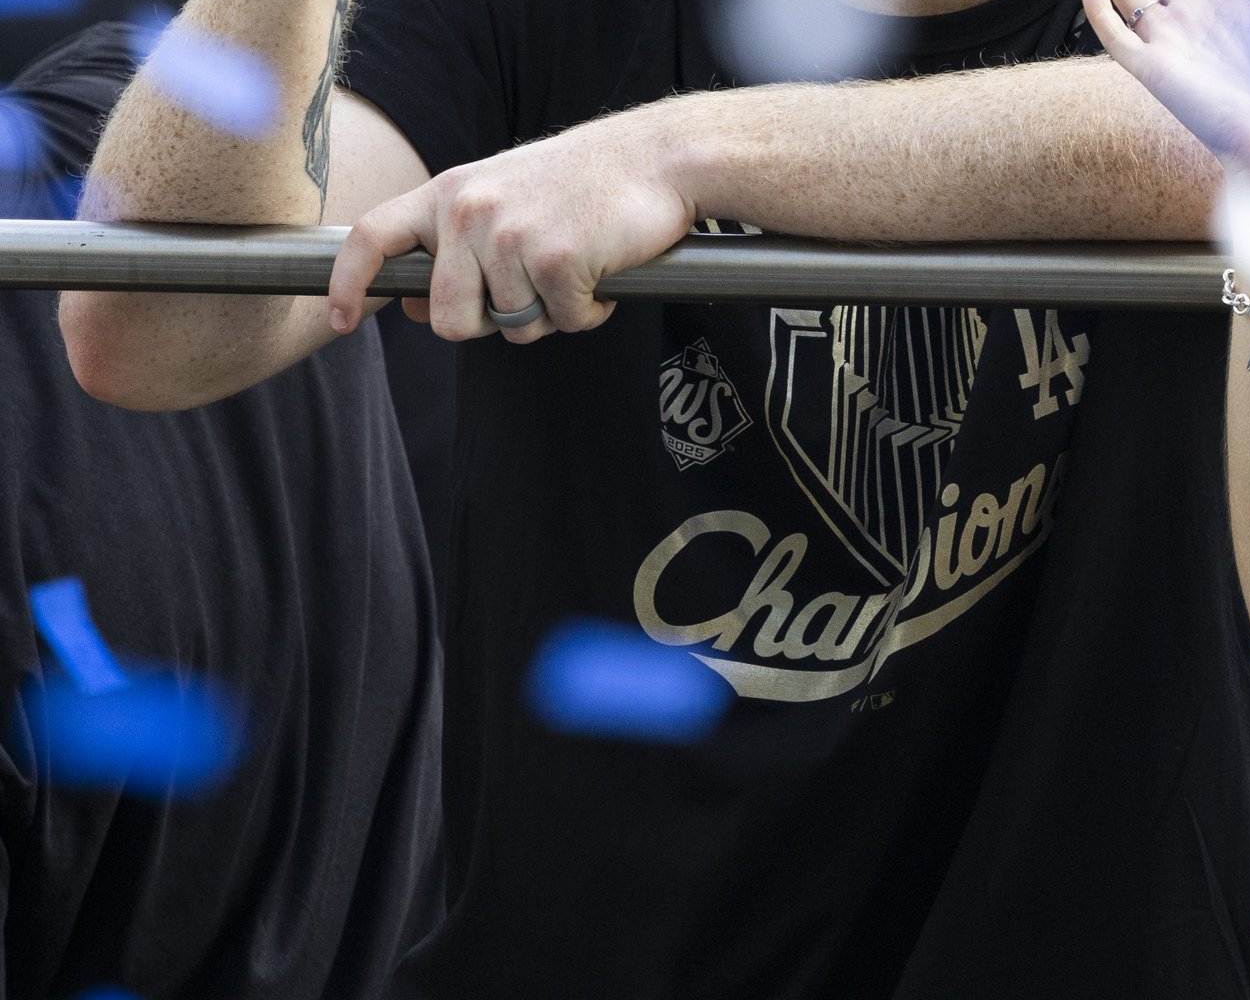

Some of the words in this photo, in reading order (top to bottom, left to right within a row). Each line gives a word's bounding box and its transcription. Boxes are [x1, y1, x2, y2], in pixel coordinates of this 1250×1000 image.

[659, 368, 733, 445] WS
[1013, 308, 1091, 421] LA
[667, 435, 706, 460] 2025
[633, 452, 1064, 661] Chaion
